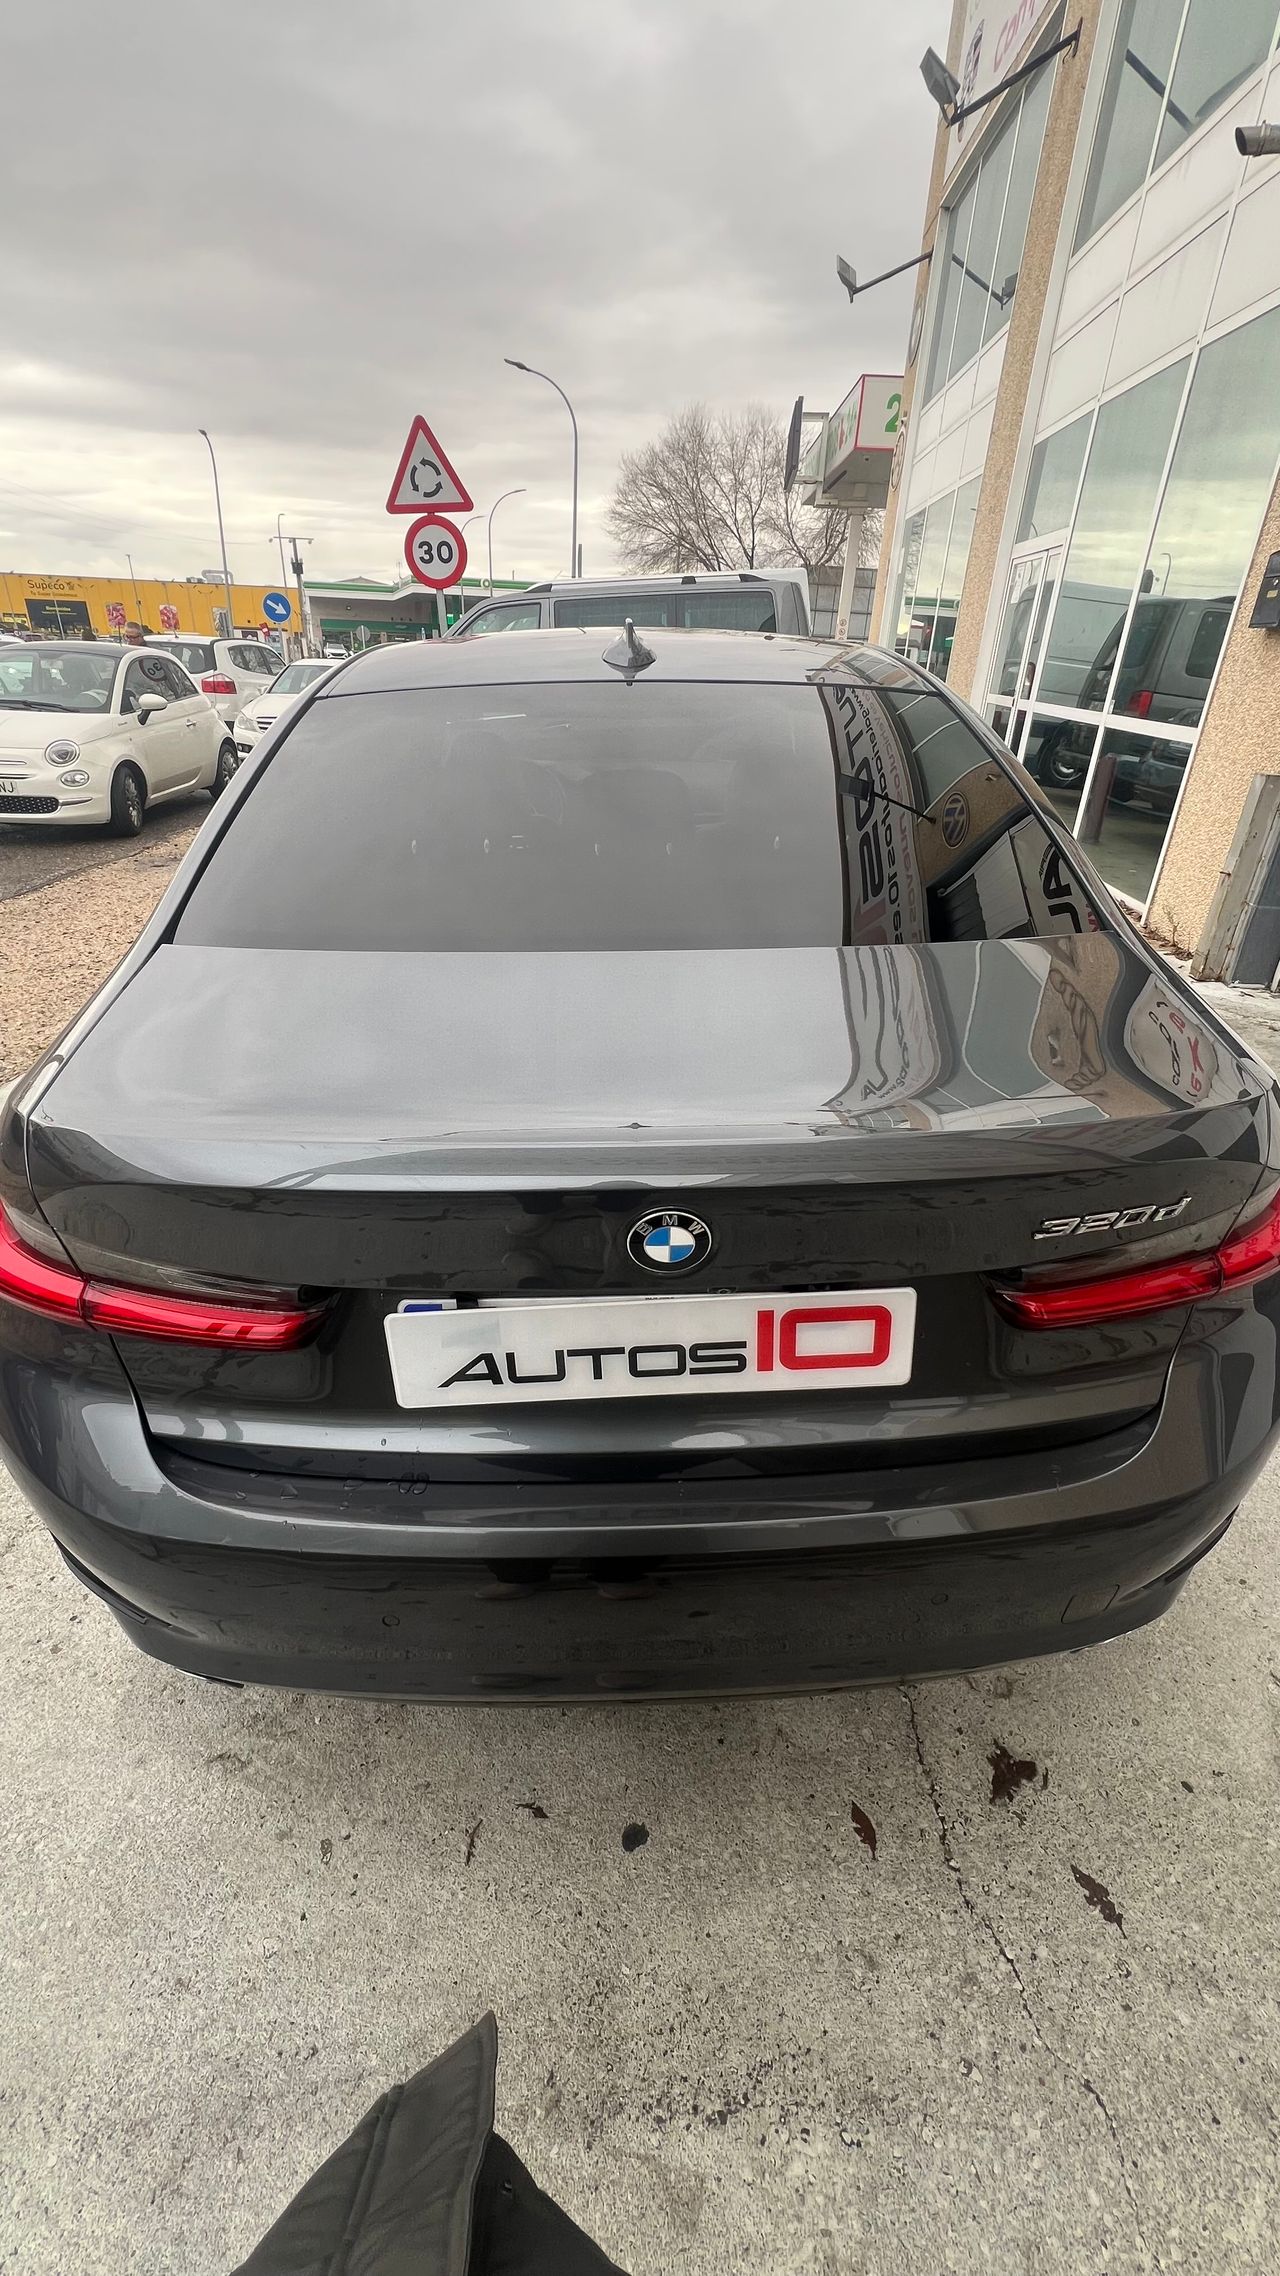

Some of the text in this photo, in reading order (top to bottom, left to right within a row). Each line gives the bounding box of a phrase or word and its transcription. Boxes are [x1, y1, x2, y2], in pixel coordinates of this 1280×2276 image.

[418, 540, 454, 565] 30
[27, 579, 65, 591] Supeco
[636, 1215, 705, 1236] BMW
[1033, 1197, 1192, 1240] 320d
